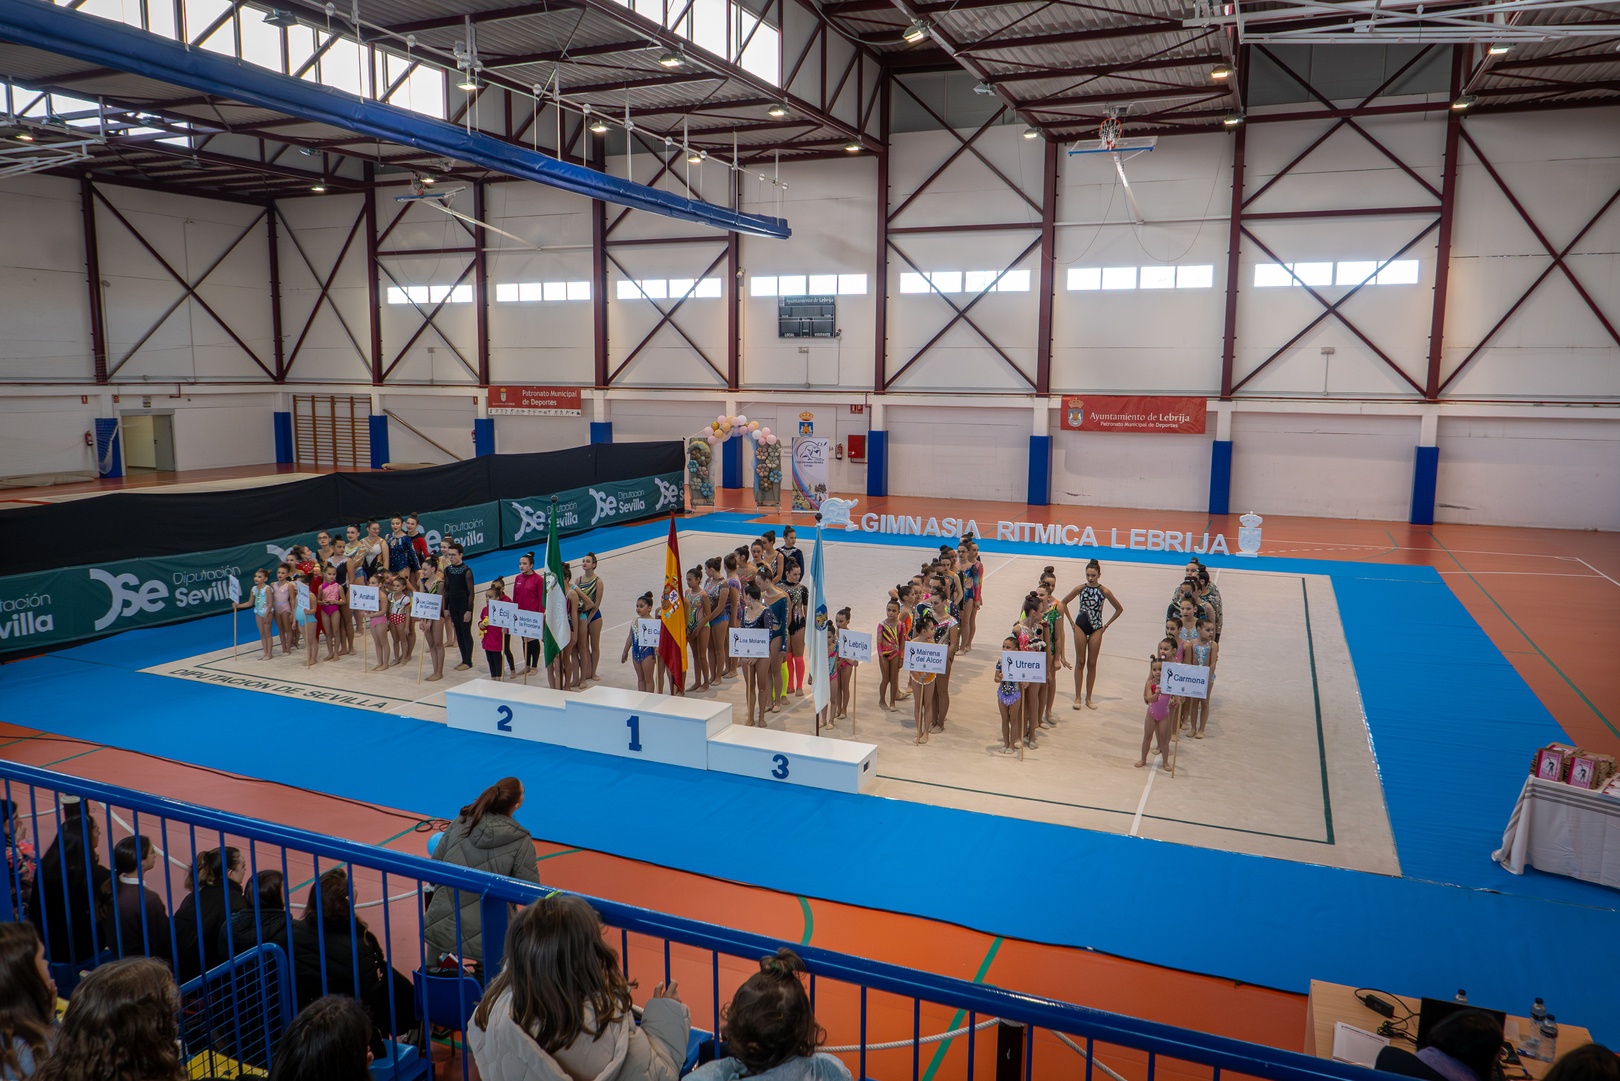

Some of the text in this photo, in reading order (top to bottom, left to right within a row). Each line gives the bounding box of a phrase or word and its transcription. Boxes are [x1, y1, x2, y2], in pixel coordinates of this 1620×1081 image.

[550, 390, 577, 398] Municipal
[531, 399, 557, 407] Deportes
[1090, 412, 1190, 424] Ayuntamiento de Lebrija
[618, 489, 645, 500] Diputación
[619, 499, 645, 514] Sevilla
[444, 519, 484, 534] Diputación
[861, 513, 1230, 555] GIMNASIA RITMICA LEBRIJA
[173, 565, 241, 586] Diputación
[175, 579, 242, 607] Sevill
[359, 593, 375, 601] Arahal
[499, 608, 509, 620] Écij
[848, 639, 868, 651] Lebrija
[916, 648, 940, 657] Mairena
[915, 655, 942, 664] del Alcor
[1015, 659, 1040, 669] Utrera
[1173, 674, 1205, 685] Carmona
[169, 668, 388, 709] DIPUTACION DE SEVILLA
[497, 705, 513, 732] 2
[626, 715, 642, 752] 1
[771, 754, 789, 780] 3
